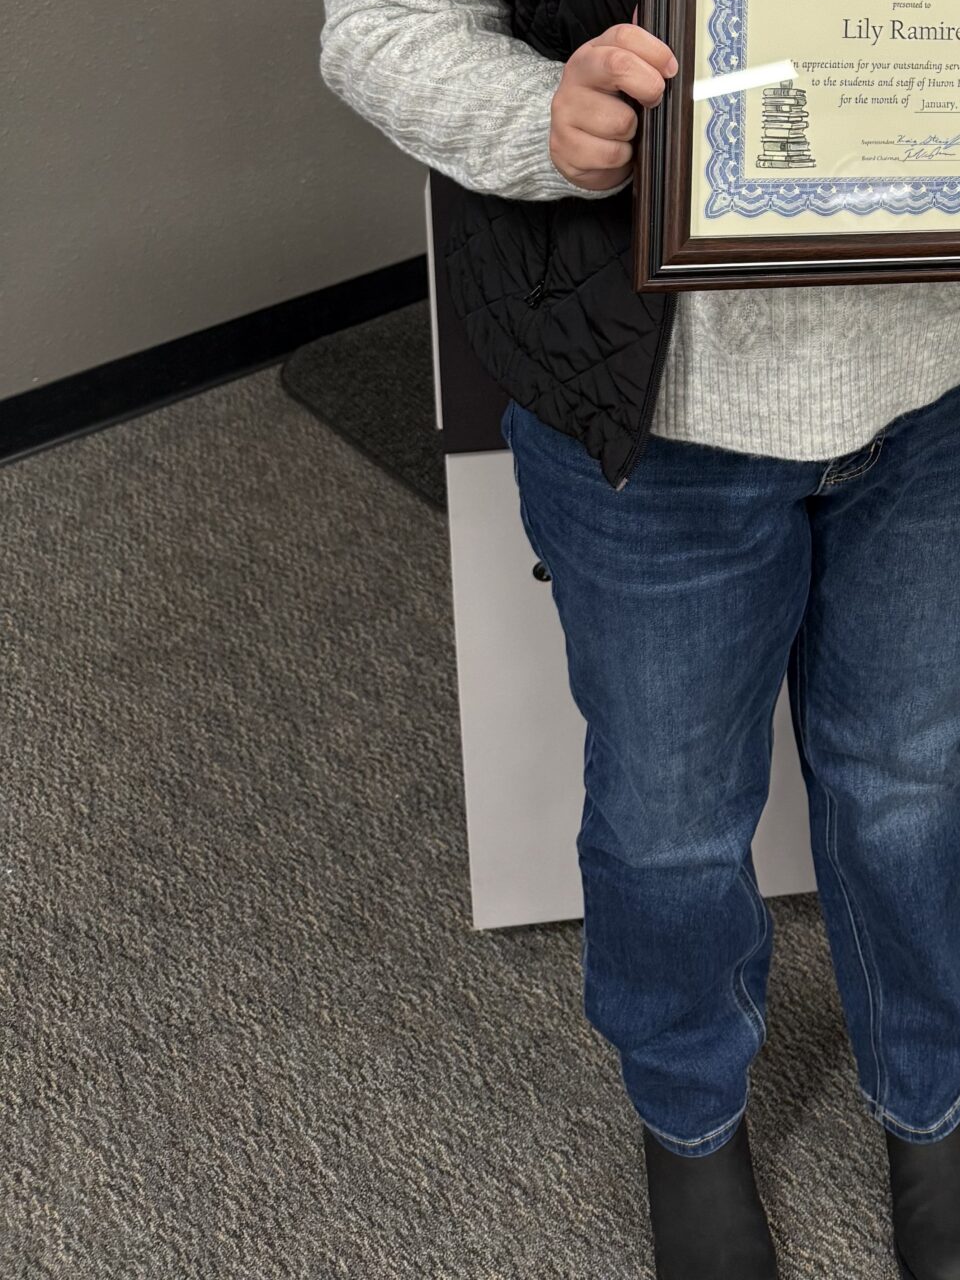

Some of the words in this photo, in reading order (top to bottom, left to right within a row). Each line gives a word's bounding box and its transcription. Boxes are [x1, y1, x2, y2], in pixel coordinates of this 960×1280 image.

[892, 0, 923, 10] presented
[842, 18, 884, 46] Lily
[802, 60, 855, 72] appreciation
[855, 59, 869, 72] for
[870, 62, 890, 73] your
[893, 60, 943, 73] outstanding
[811, 78, 820, 86] to
[823, 76, 837, 87] the
[840, 77, 875, 87] students
[878, 77, 893, 87] and
[896, 77, 916, 90] staff
[917, 77, 926, 91] of
[928, 79, 954, 88] Huron
[838, 94, 852, 108] for
[855, 94, 868, 104] the
[871, 95, 898, 104] month
[901, 95, 911, 108] of
[920, 100, 958, 111] January,
